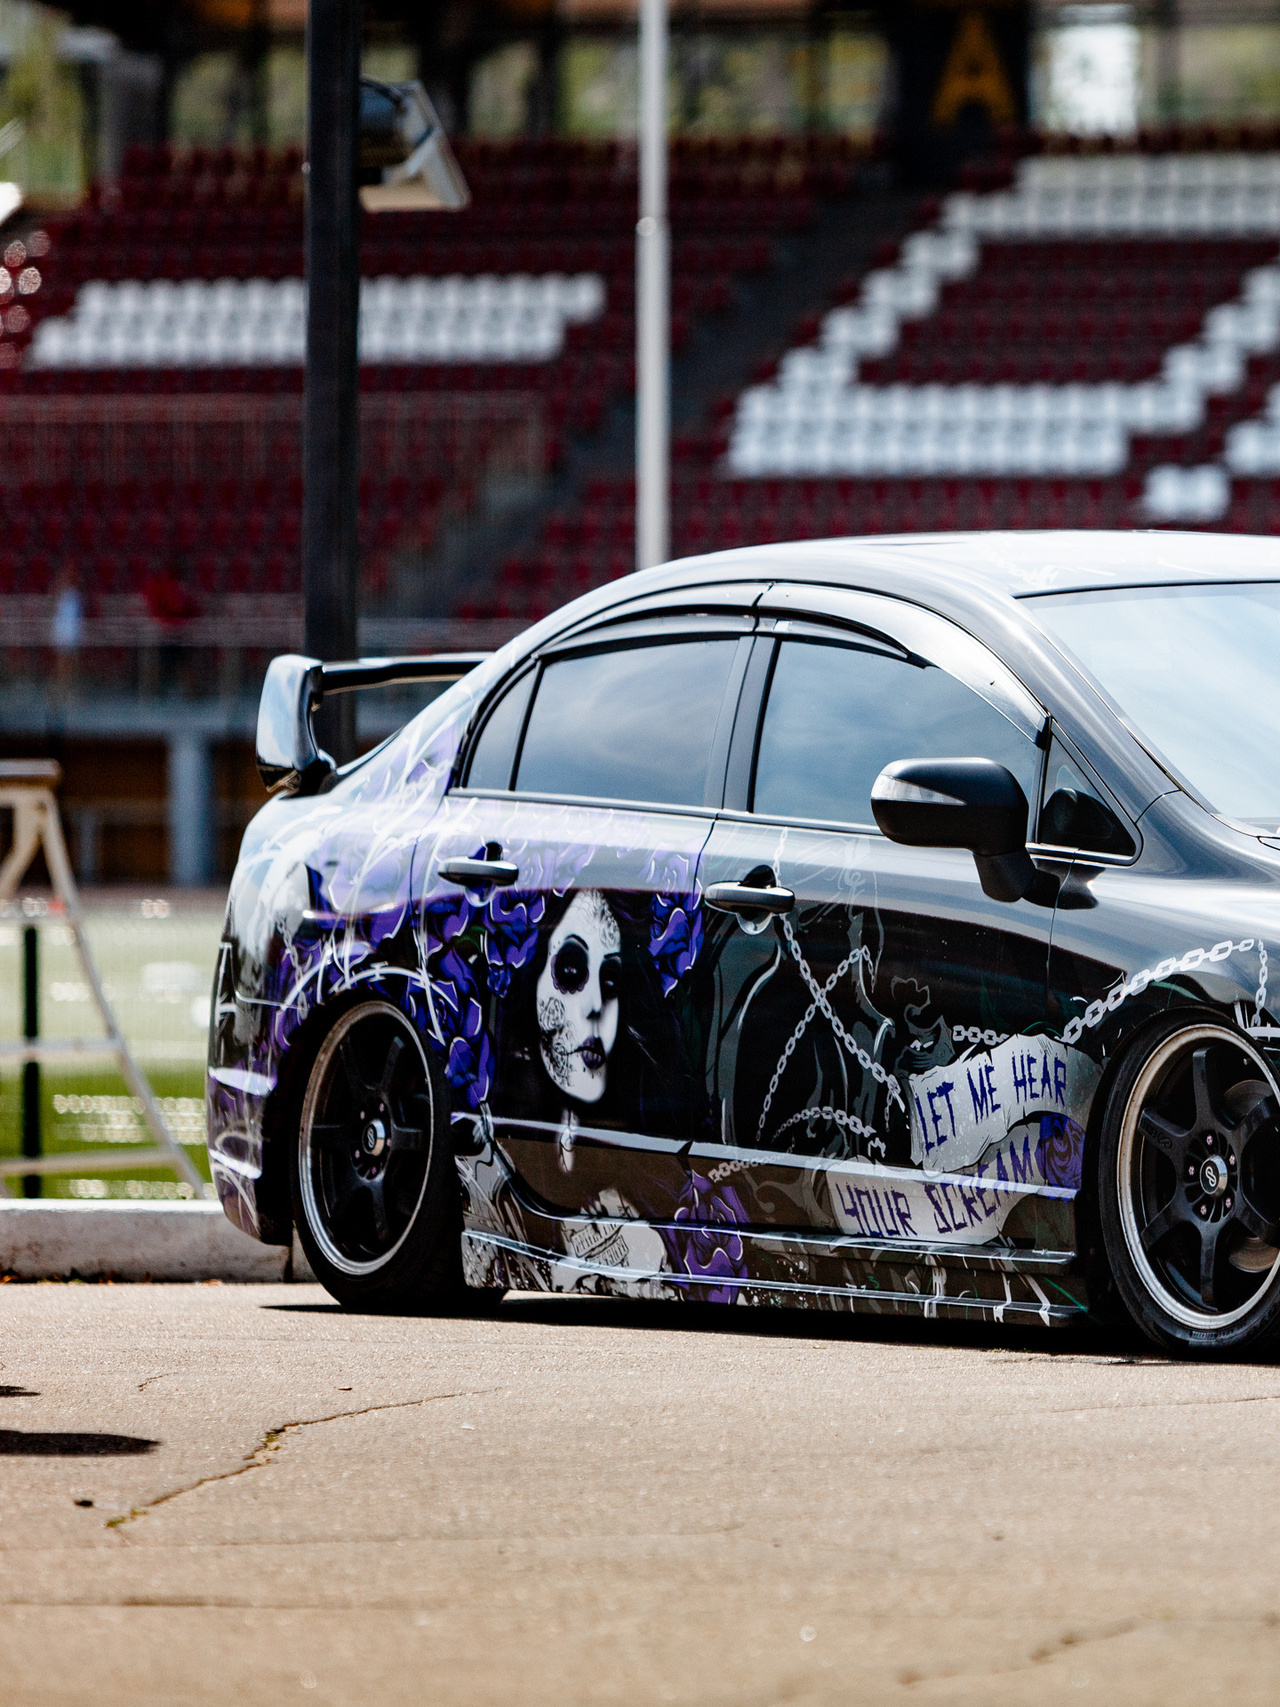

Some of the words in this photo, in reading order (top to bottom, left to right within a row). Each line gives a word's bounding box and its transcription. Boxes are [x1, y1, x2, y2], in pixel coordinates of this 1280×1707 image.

[914, 1080, 957, 1157] LET
[966, 1059, 1001, 1125] ME
[1011, 1050, 1067, 1107] HEAR
[835, 1182, 918, 1237] YOUR
